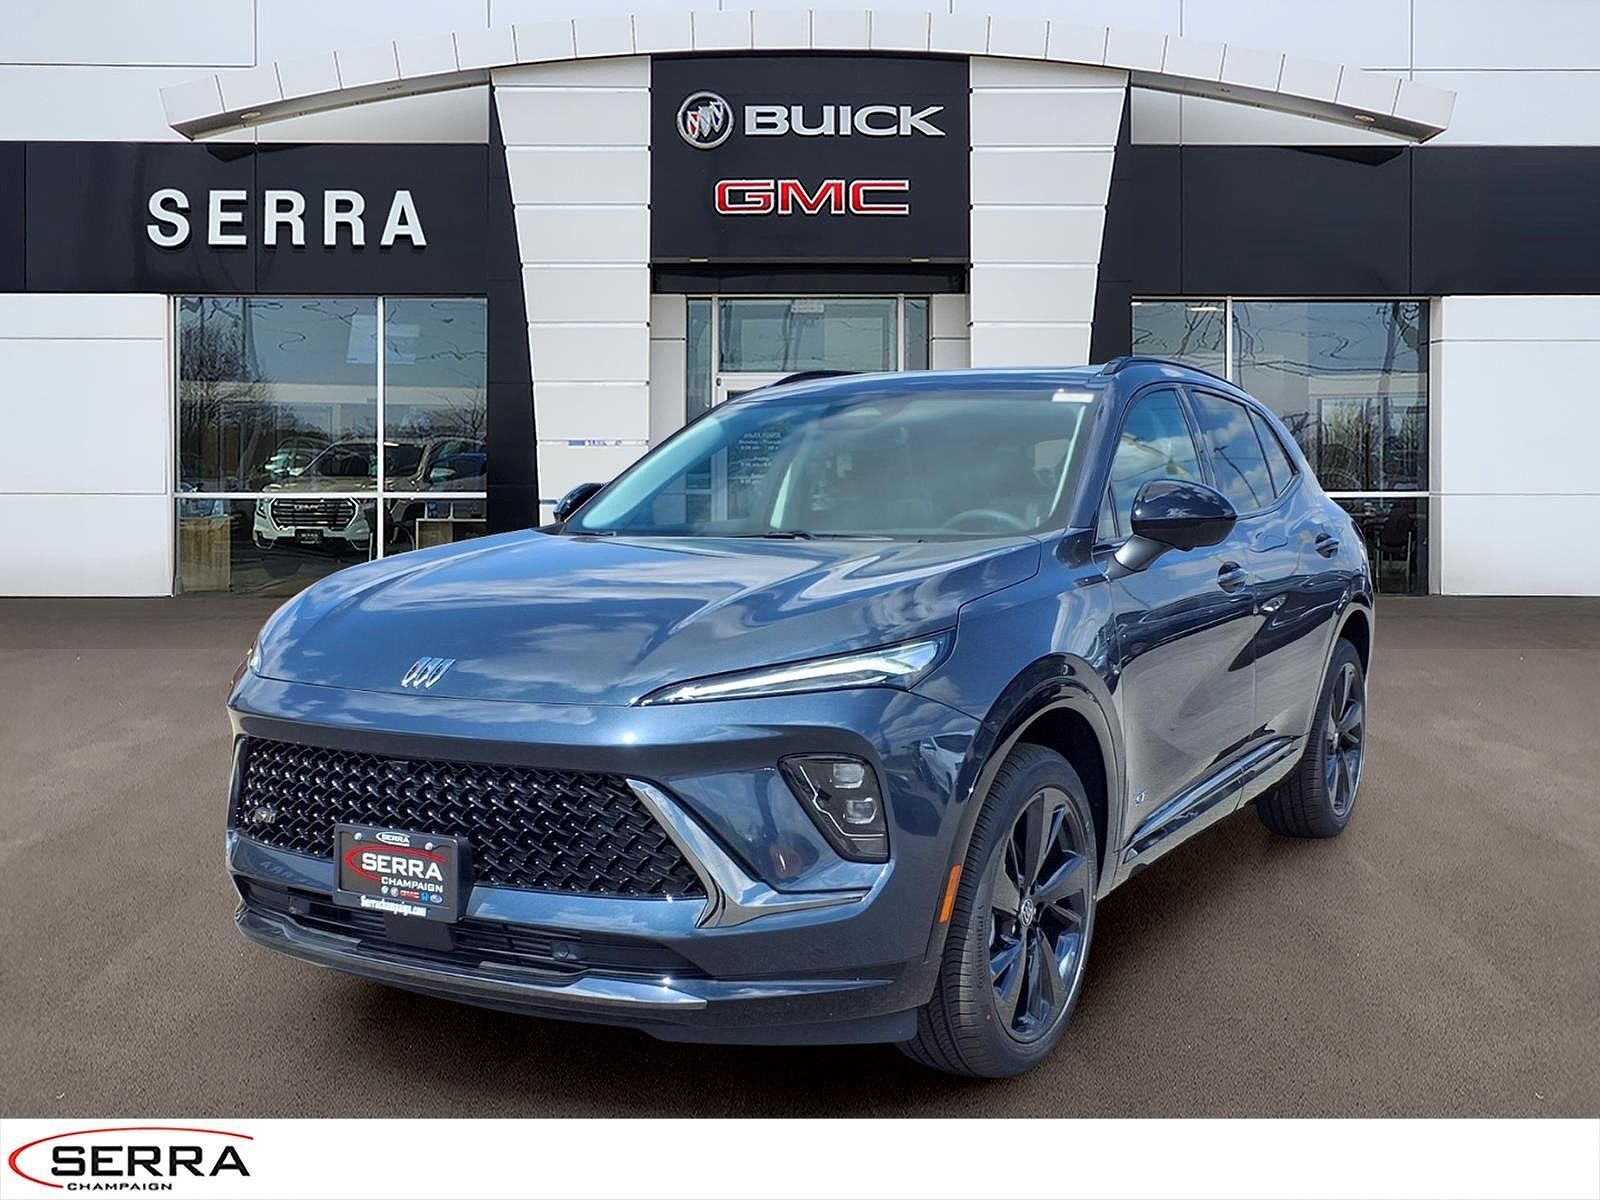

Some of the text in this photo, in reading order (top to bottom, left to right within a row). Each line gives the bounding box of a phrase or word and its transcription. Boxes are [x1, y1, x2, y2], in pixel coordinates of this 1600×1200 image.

[744, 105, 946, 136] BUICK
[714, 179, 910, 215] GMC
[147, 188, 427, 248] SERRA
[381, 833, 410, 844] SERRA
[361, 852, 443, 881] SERRA
[381, 876, 444, 893] CHAMPAIGN
